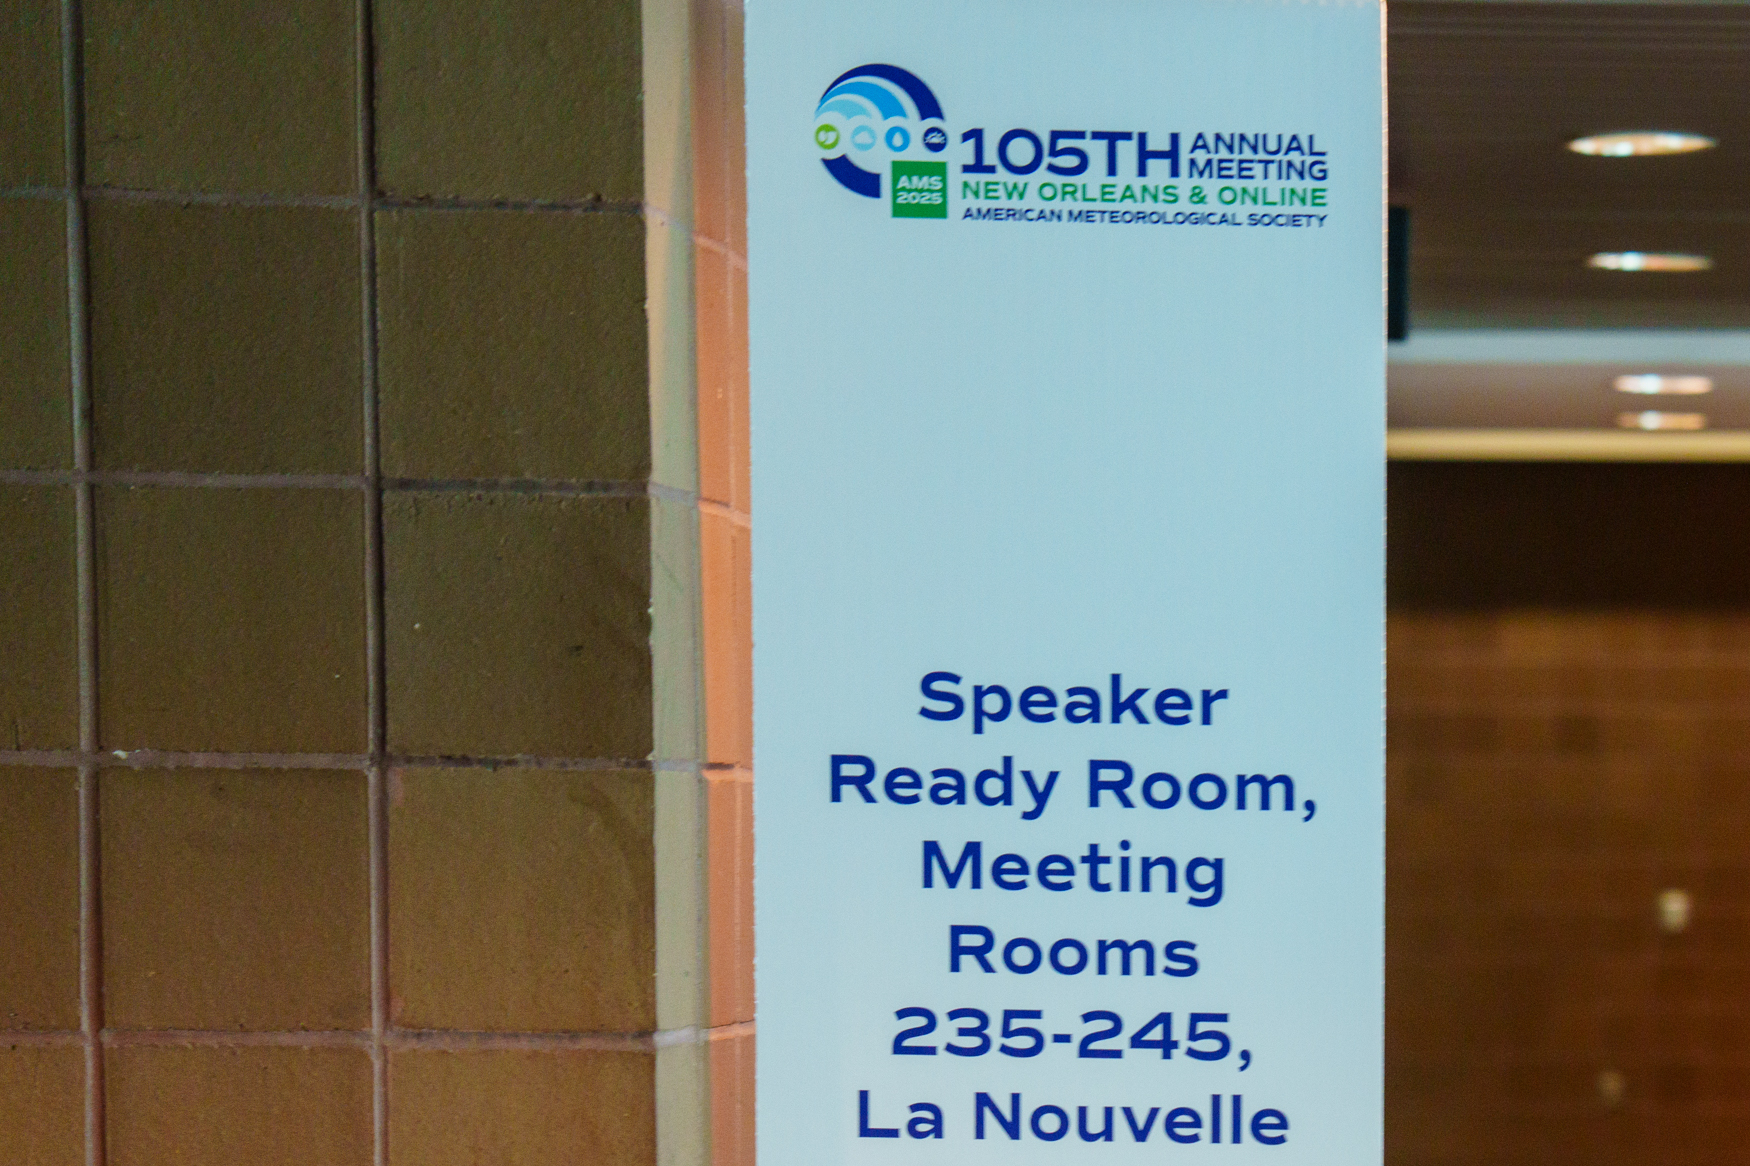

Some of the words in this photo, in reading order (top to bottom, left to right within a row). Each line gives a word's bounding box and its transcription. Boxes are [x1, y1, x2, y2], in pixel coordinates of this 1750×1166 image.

[960, 128, 1181, 178] 105TH
[1188, 132, 1327, 156] ANNUAL
[896, 174, 943, 190] AMS
[962, 181, 1028, 200] NEW
[1038, 182, 1179, 204] ORLEANS
[1188, 185, 1207, 205] &
[1218, 186, 1328, 207] ONLINE
[1188, 158, 1328, 181] MEETING
[895, 191, 943, 204] 2025
[962, 207, 1062, 222] AMERICAN
[1068, 210, 1243, 226] METEOROLOGICAL
[1248, 213, 1328, 228] SOCIETY
[919, 671, 1229, 735] Speaker
[830, 754, 1060, 821] Ready
[1088, 759, 1318, 823] Room,
[922, 839, 1224, 908] Meeting
[949, 924, 1200, 978] Rooms
[892, 1006, 1253, 1072] 235-245,
[858, 1089, 944, 1140] La
[975, 1092, 1289, 1146] Nouvelle
